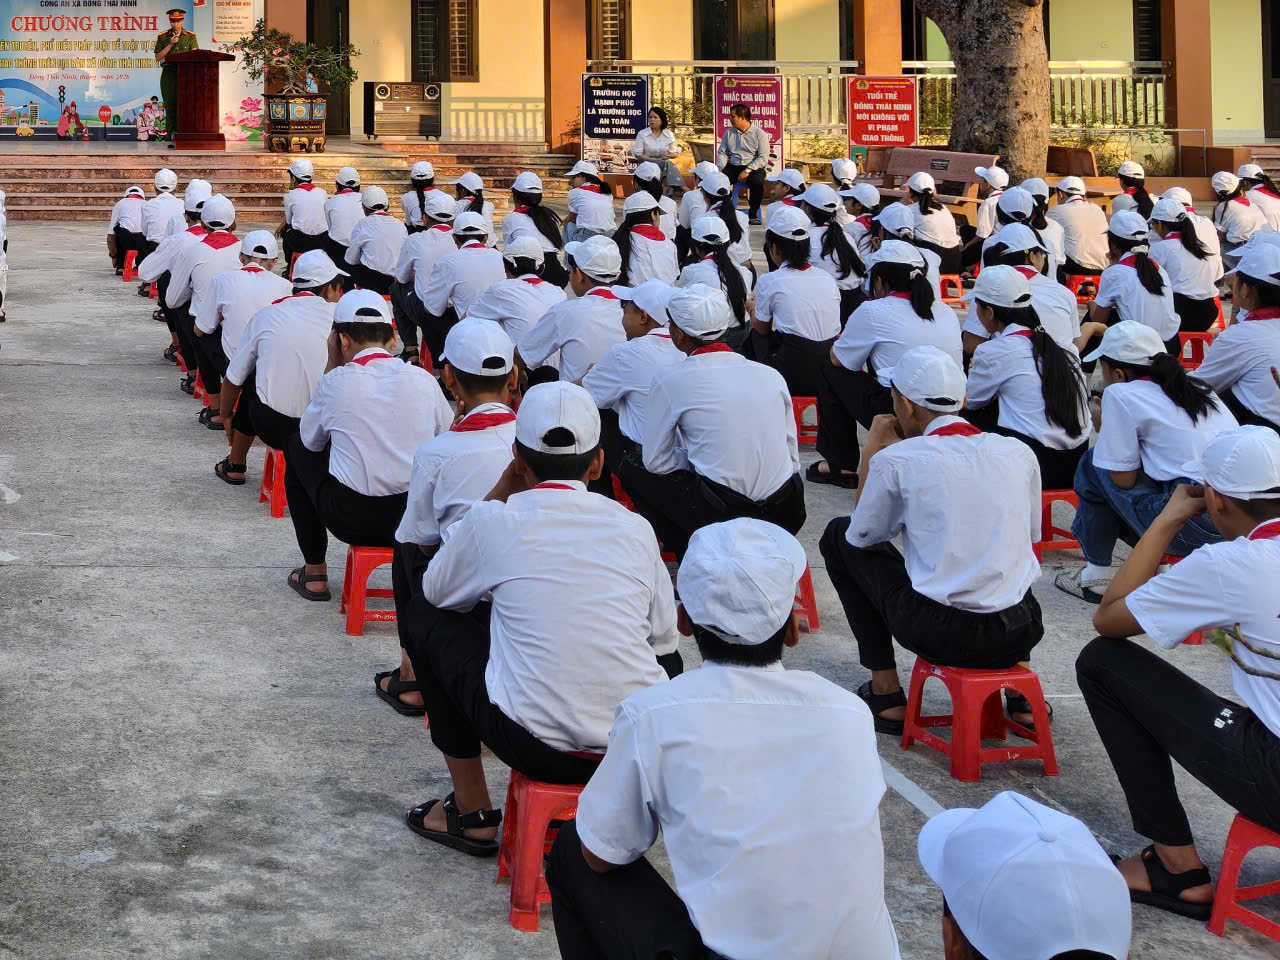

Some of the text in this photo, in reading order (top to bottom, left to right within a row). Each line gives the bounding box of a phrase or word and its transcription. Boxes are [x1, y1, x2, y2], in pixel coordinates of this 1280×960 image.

[11, 12, 158, 31] CHƯƠNG TRÌNH
[592, 88, 636, 98] TRƯỜNG HỌC
[741, 93, 753, 102] CHA
[616, 98, 634, 106] PHÚC
[598, 108, 625, 116] TRƯỜNG
[871, 112, 896, 120] KHÔNG
[612, 126, 636, 134] THÔNG
[880, 134, 904, 142] THÔNG
